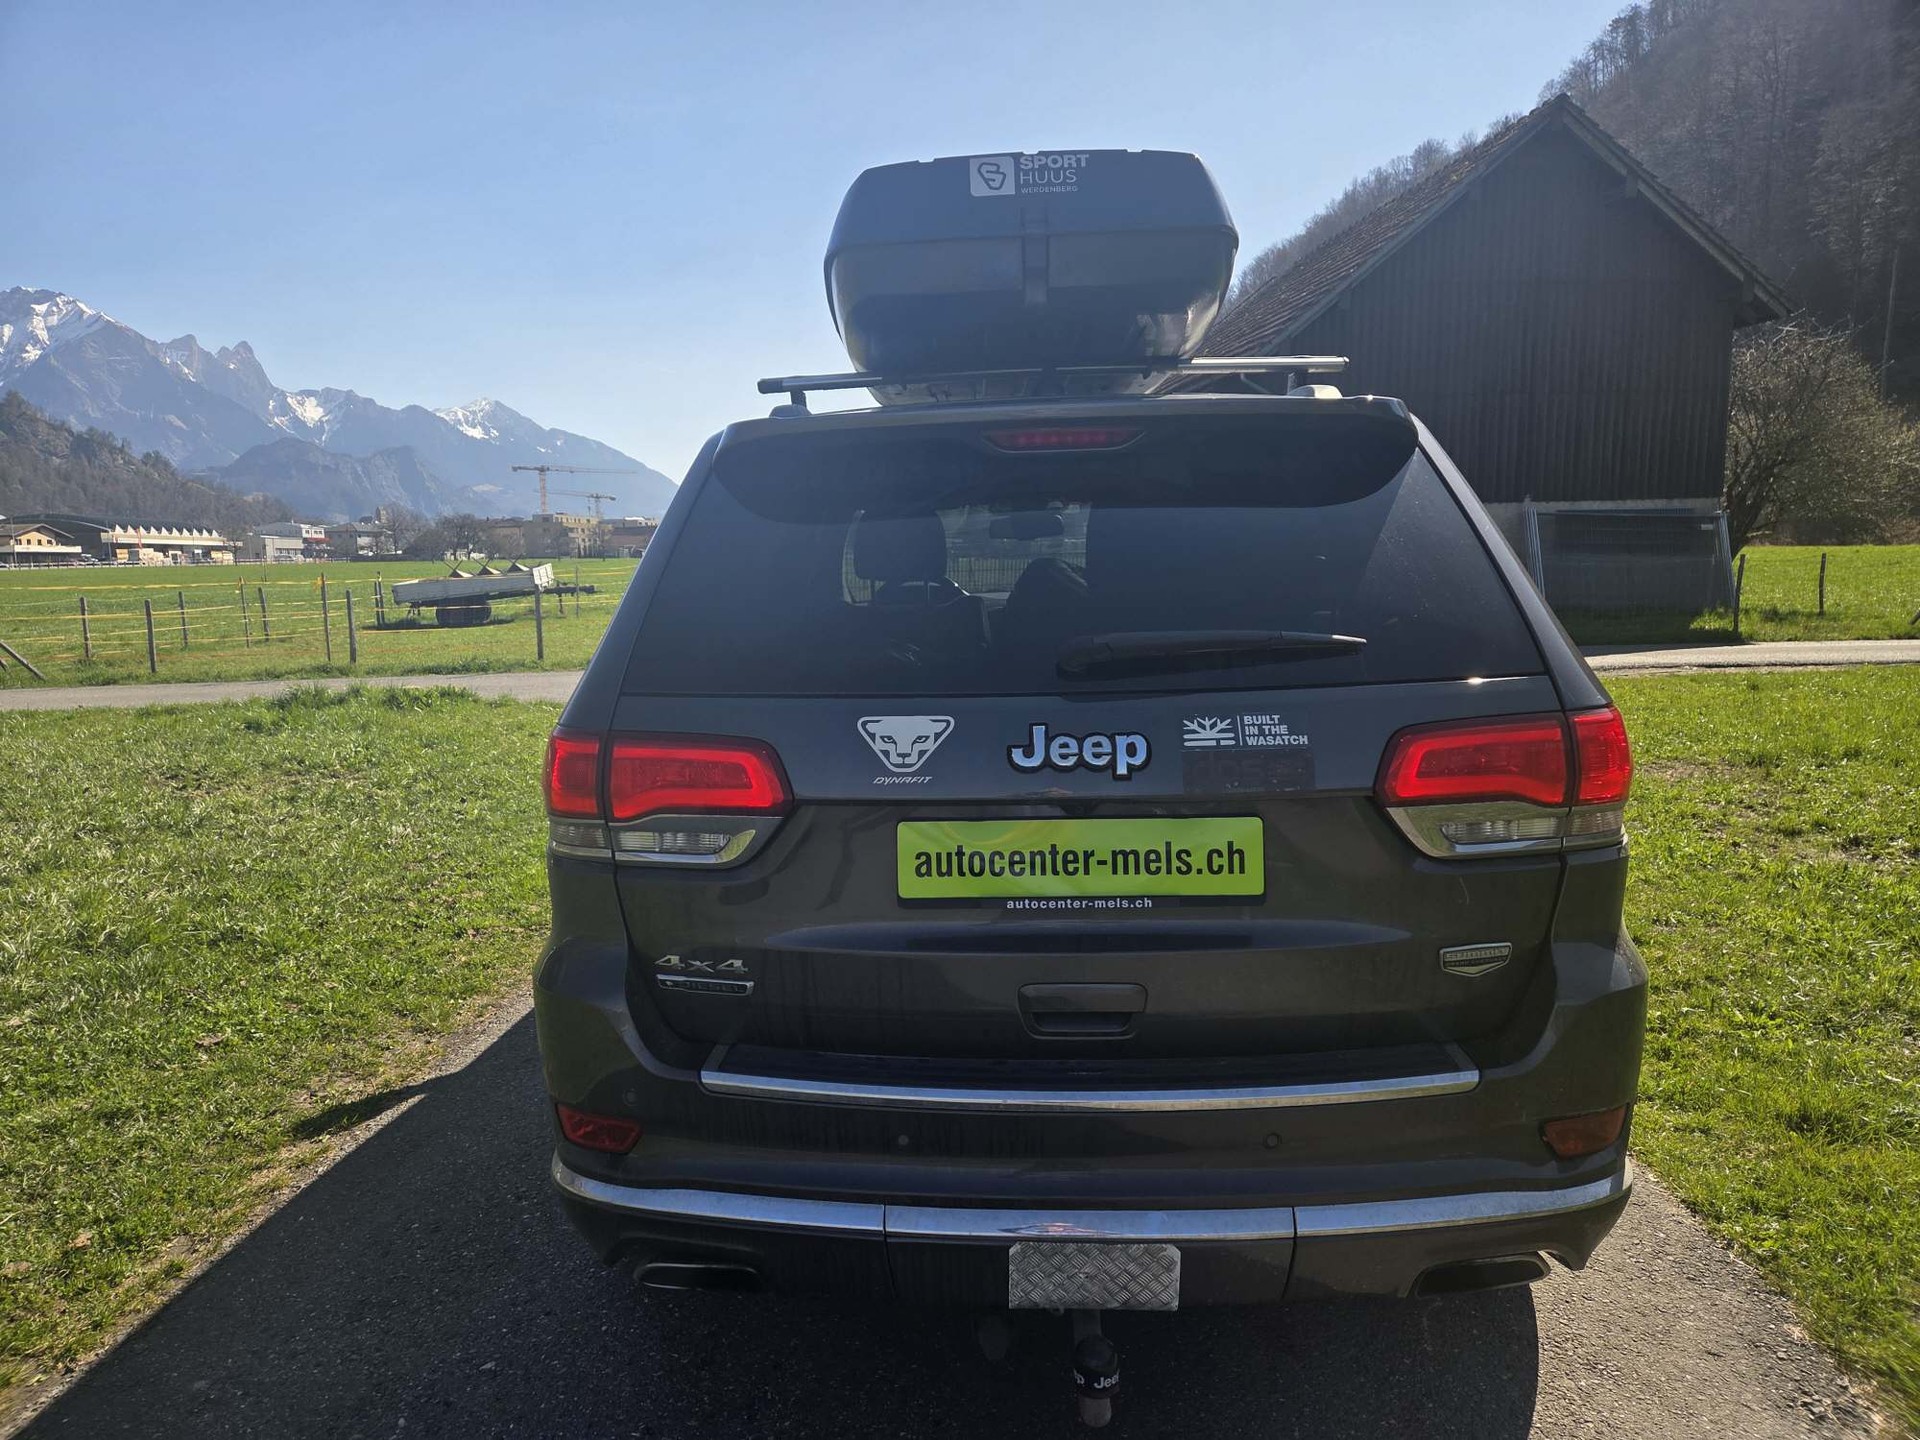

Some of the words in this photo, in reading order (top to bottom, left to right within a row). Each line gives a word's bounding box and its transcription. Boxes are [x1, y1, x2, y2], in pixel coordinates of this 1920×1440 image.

[1020, 154, 1090, 169] SPORT
[1020, 169, 1077, 185] HUUS
[1243, 714, 1280, 725] BUILT
[1244, 725, 1259, 735] IN
[1262, 724, 1289, 735] THE
[1245, 734, 1309, 746] WASATCH
[1010, 723, 1150, 777] Jeep
[872, 775, 933, 787] DYNAFIT
[914, 840, 1246, 878] autocenter-mels.ch
[1006, 897, 1153, 910] autocenter-mels.ch
